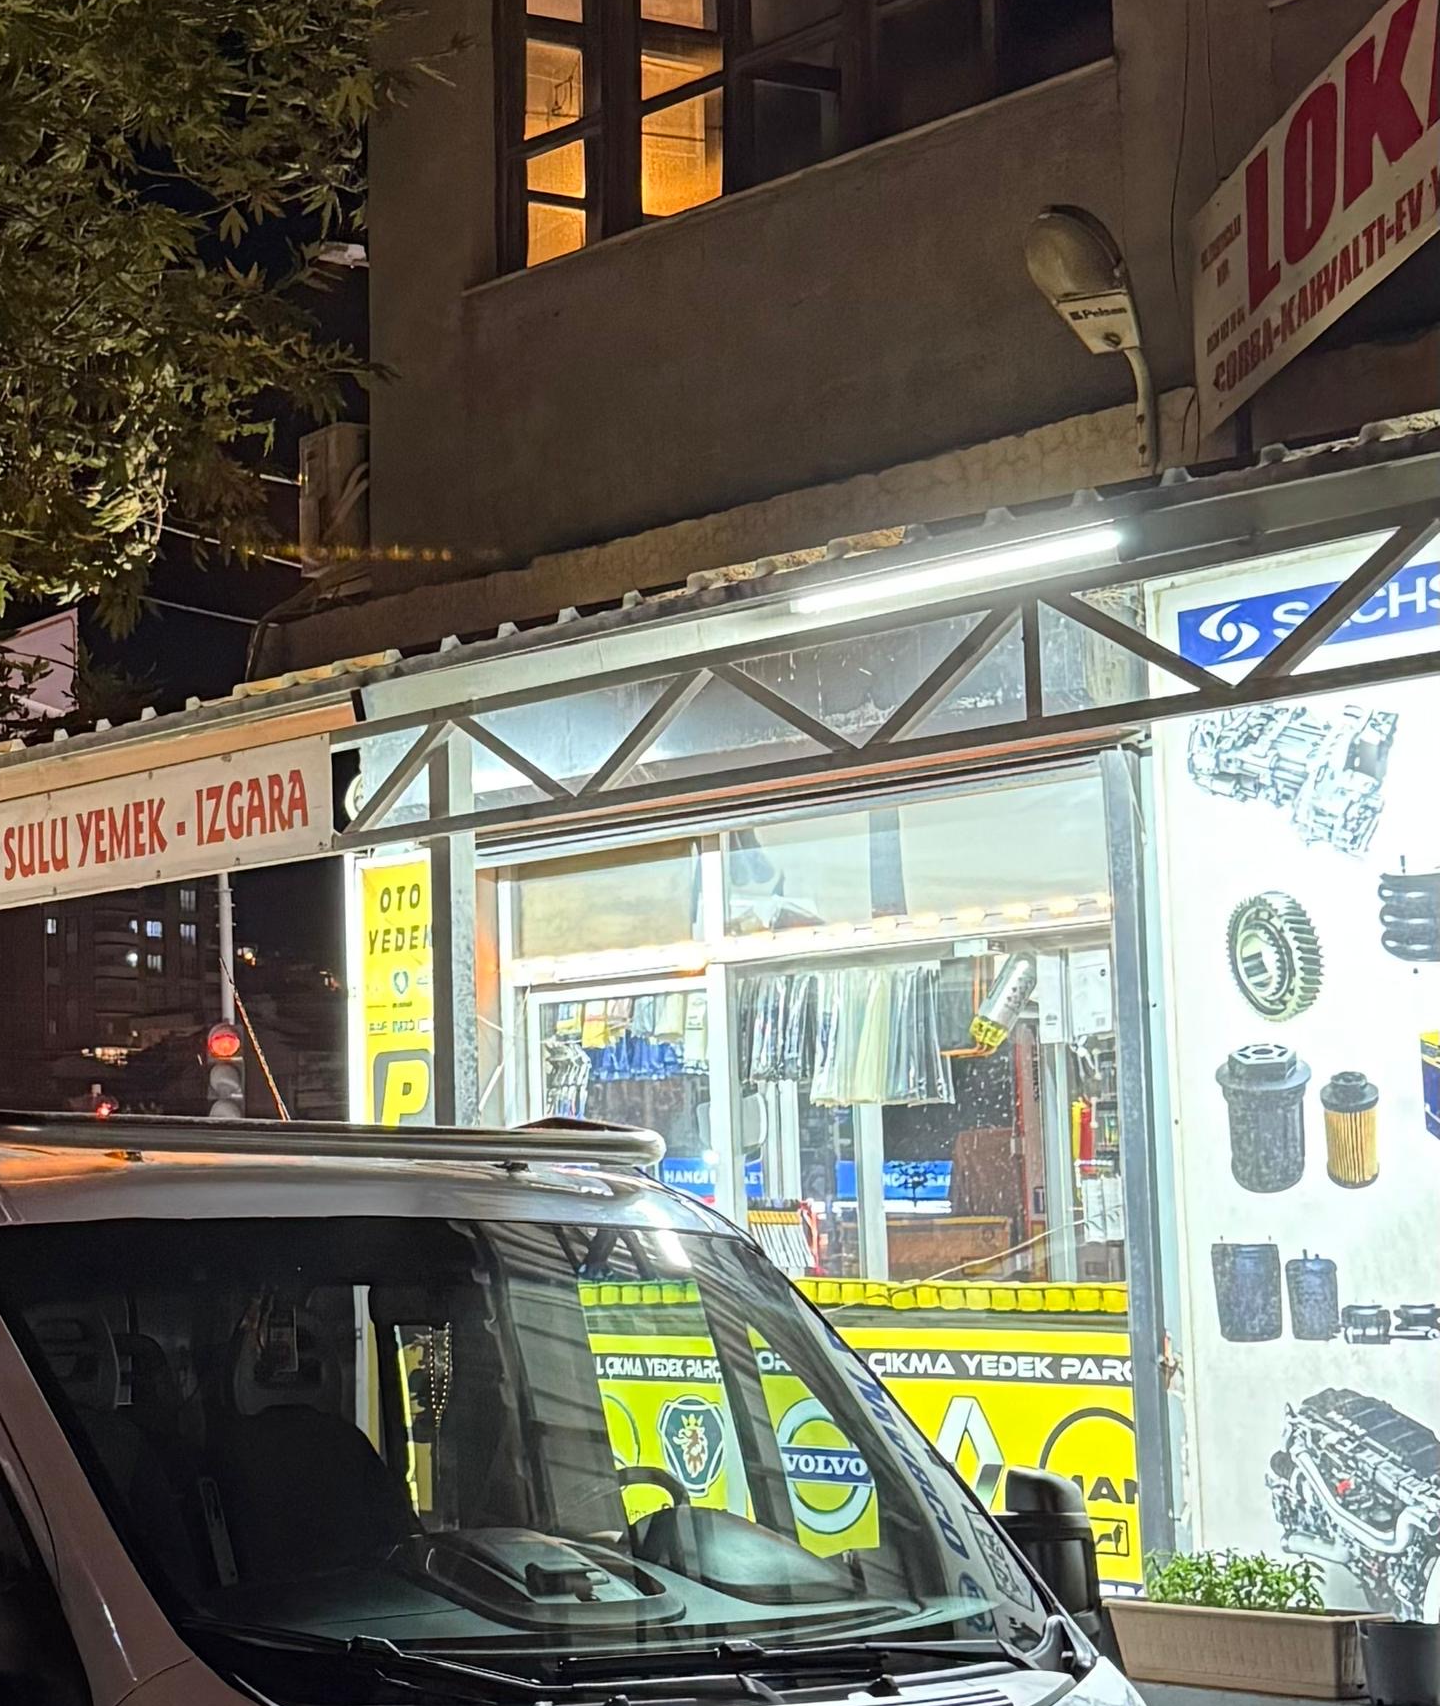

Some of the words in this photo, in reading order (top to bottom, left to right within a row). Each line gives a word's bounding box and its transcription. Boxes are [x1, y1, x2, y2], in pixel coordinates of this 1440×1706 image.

[3, 815, 68, 882] SULU
[75, 796, 168, 869] YEMEK
[195, 768, 309, 847] IZGARA
[379, 883, 421, 914] OTO
[606, 1356, 645, 1380] ÇIKMA
[646, 1357, 686, 1378] YEDEK
[867, 1352, 956, 1378] ÇIKMA
[960, 1353, 1055, 1380] YEDEK
[781, 1453, 869, 1477] VOLVO
